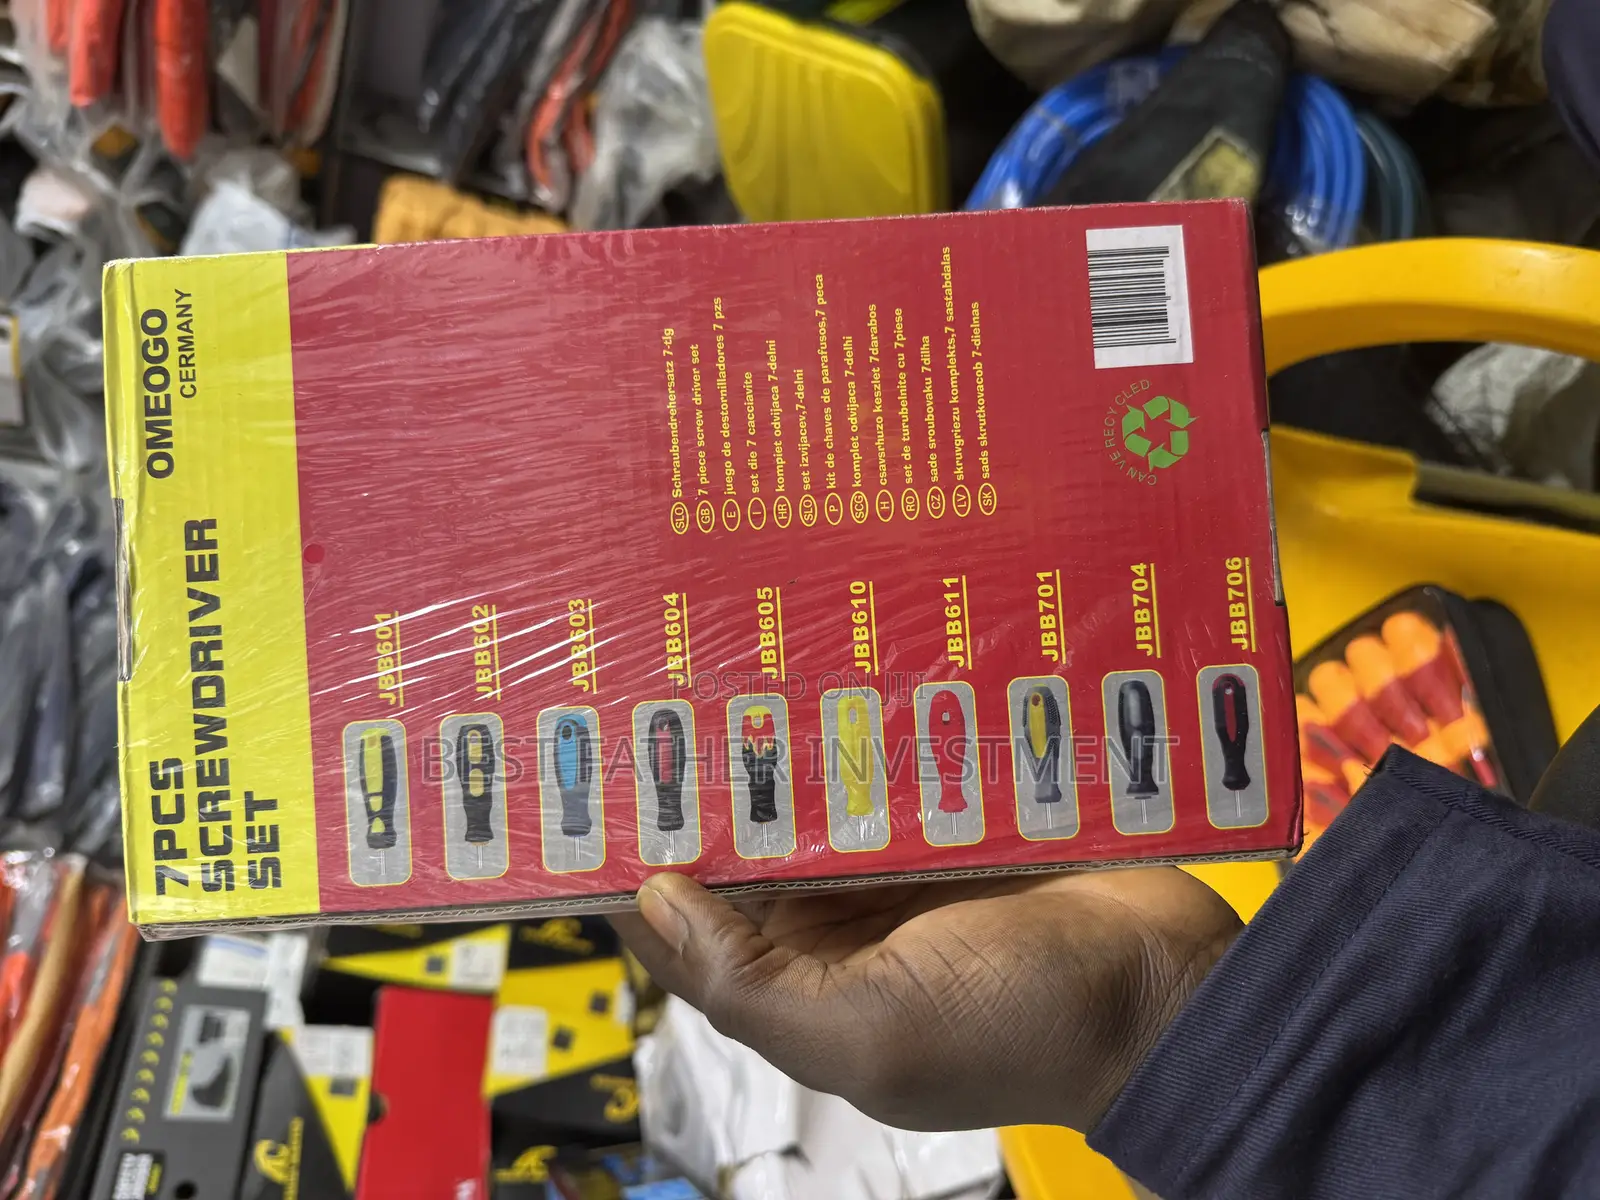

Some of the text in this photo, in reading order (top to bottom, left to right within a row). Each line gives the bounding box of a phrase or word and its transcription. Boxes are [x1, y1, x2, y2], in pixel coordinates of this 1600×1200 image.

[714, 298, 725, 320] pzs
[816, 274, 827, 305] peca
[942, 247, 954, 322] sastabdalas
[174, 288, 197, 399] CERMANY
[663, 328, 674, 356] 7-tlg
[690, 344, 700, 364] set
[816, 310, 832, 384] parafusos,7
[868, 304, 880, 363] 7darabos
[894, 308, 906, 348] 7piese
[920, 336, 931, 373] 7dilha
[970, 302, 982, 358] 7-dielnas
[766, 340, 778, 381] 7-delni
[843, 336, 854, 376] 7-delhi
[898, 353, 906, 368] cu
[944, 326, 960, 404] komplekts,7
[140, 308, 174, 479] OMEOGO
[692, 368, 702, 405] driver
[717, 335, 730, 438] destornilladores
[744, 371, 756, 435] cacciavite
[771, 386, 783, 437] odvijaca
[821, 388, 831, 404] de
[848, 381, 862, 432] odvijaca
[872, 368, 883, 413] keszlet
[898, 372, 910, 442] turubelnite
[974, 362, 988, 446] skrutkovacob
[666, 360, 683, 498] Schraubendrehersatz
[696, 409, 704, 447] screw
[795, 369, 810, 467] izvijacev,7-delni
[824, 407, 834, 450] chaves
[924, 377, 936, 450] sroubovaku
[698, 451, 709, 484] piece
[722, 441, 731, 457] de
[748, 451, 758, 470] die
[775, 440, 786, 492] kompiet
[825, 453, 835, 468] de
[850, 435, 863, 488] komplet
[875, 415, 888, 486] csavsrhuzo
[900, 445, 912, 461] de
[928, 453, 939, 482] sade
[952, 407, 964, 480] skruvgriezu
[978, 450, 990, 479] sads
[724, 460, 736, 495] juego
[751, 474, 760, 494] set
[802, 472, 811, 490] set
[826, 472, 836, 489] kit
[904, 464, 912, 484] set
[850, 581, 872, 673] JBB610
[942, 577, 966, 668] JBB611
[1036, 572, 1059, 662] JBB701
[1130, 562, 1154, 656] JBB704
[1225, 557, 1248, 650] JBB706
[374, 613, 396, 705] JBB601
[472, 604, 493, 698] JBB602
[568, 598, 590, 692] JBB603
[662, 592, 684, 686] JBB604
[756, 586, 778, 679] JBB605
[184, 518, 235, 893] SCREWDRIVER
[149, 757, 189, 896] 7PCS
[244, 790, 283, 890] SET
